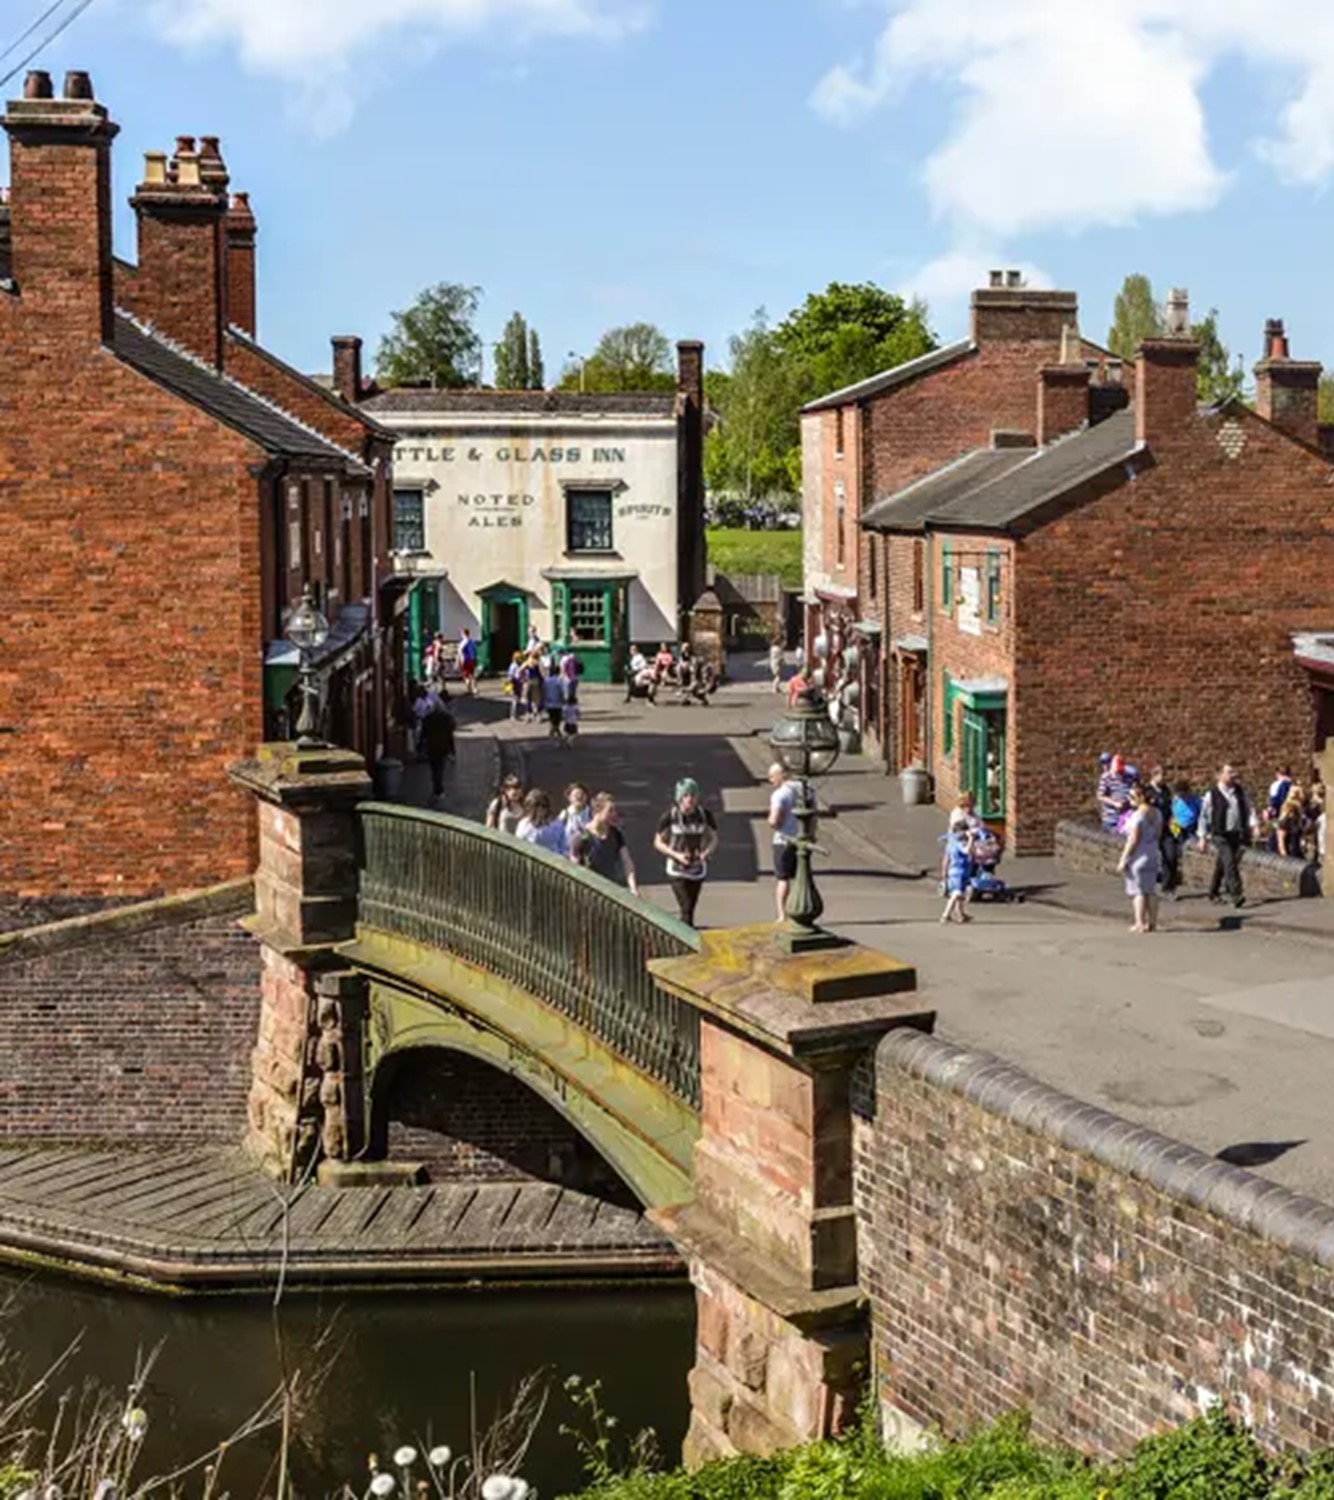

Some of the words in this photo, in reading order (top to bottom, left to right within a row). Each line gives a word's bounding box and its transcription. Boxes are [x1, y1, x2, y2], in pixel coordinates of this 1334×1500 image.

[394, 447, 455, 462] TTLE
[467, 447, 483, 462] &
[496, 447, 581, 462] GLASS
[593, 447, 626, 462] INN
[457, 494, 535, 506] NOTED
[618, 504, 672, 517] SPIRITS
[468, 516, 523, 528] ALES
